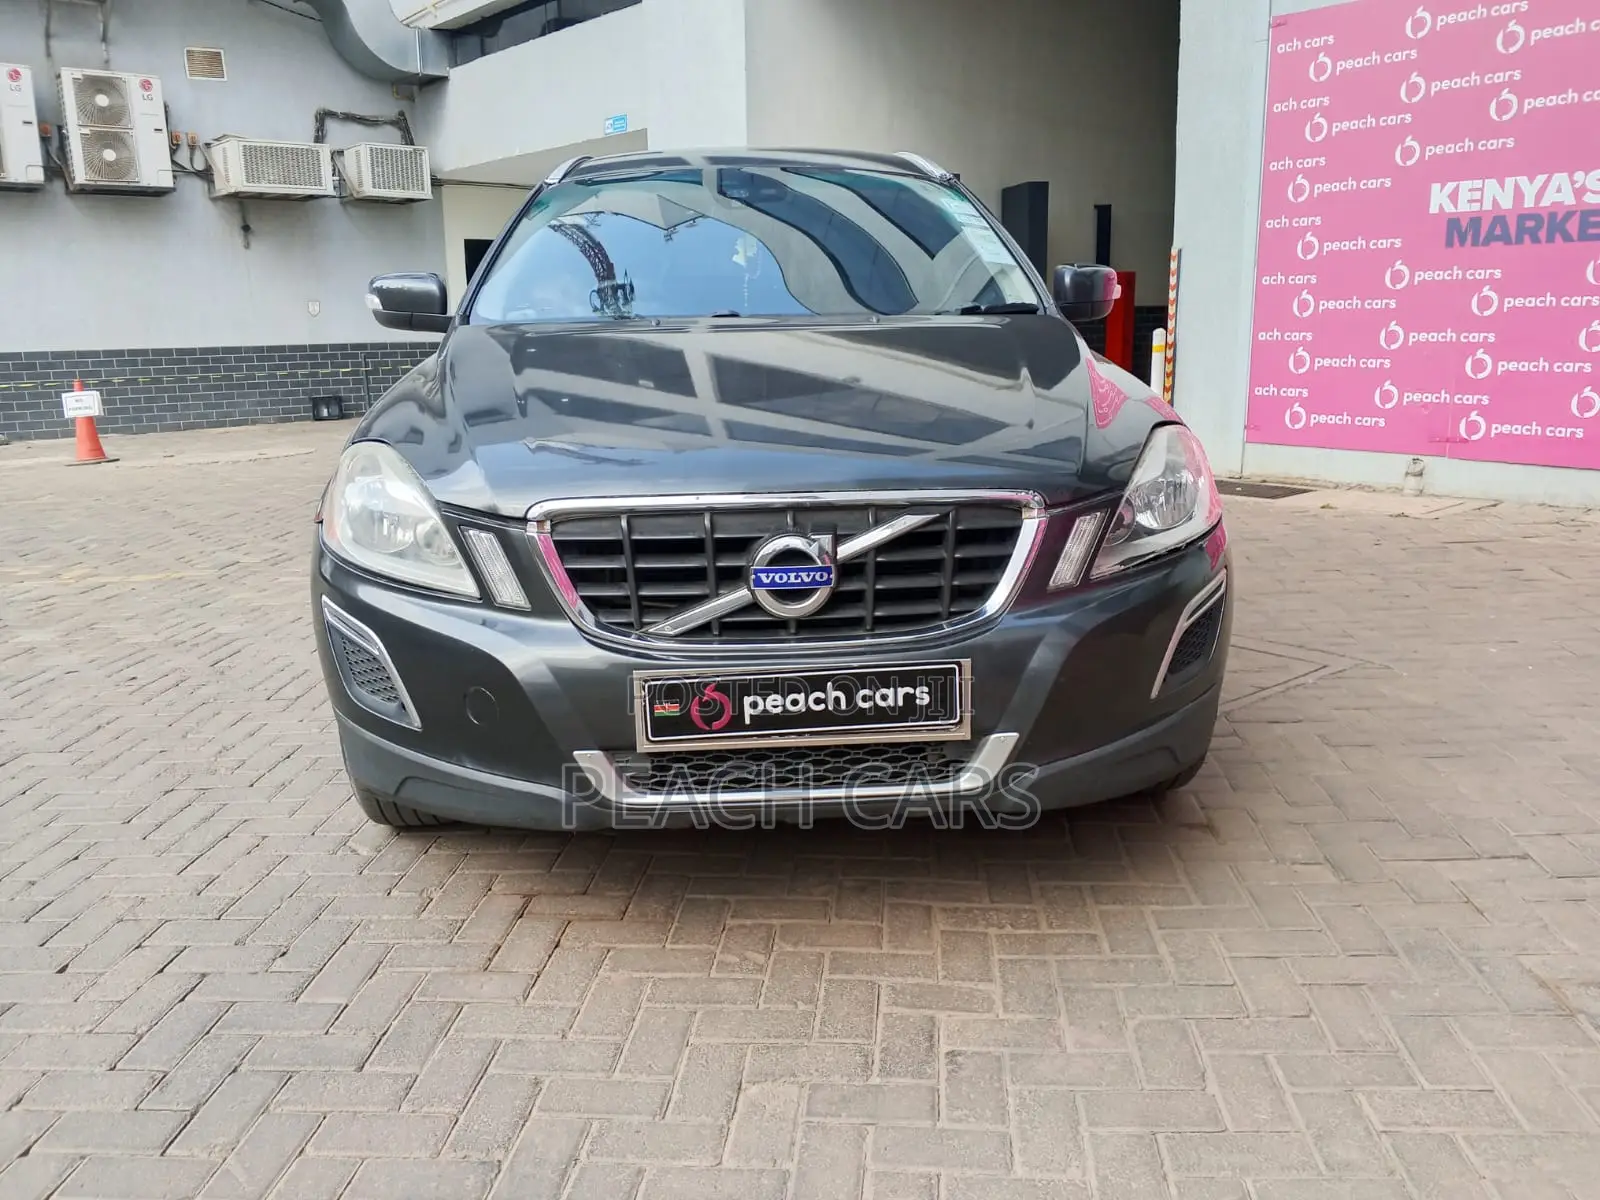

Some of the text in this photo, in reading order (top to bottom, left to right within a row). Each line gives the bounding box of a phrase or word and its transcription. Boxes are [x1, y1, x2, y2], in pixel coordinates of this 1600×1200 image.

[1436, 0, 1529, 31] peach cars
[1530, 17, 1587, 46] peach
[1276, 34, 1335, 54] ach cars
[1335, 49, 1418, 76] peach cars
[1430, 69, 1522, 97] peach cars
[1273, 96, 1330, 113] ach cars
[1522, 88, 1579, 115] peach
[1331, 113, 1412, 137] peach cars
[1425, 137, 1515, 161] peach cars
[1269, 156, 1326, 171] ach cars
[1313, 176, 1392, 198] peach cars
[1428, 168, 1600, 214] KENYA'S
[1265, 214, 1322, 229] ach cars
[1445, 209, 1600, 248] MARKE
[1323, 235, 1402, 256] peach cars
[1261, 271, 1317, 285] ach cars
[1413, 265, 1502, 286] peach cars
[1318, 295, 1397, 314] peach cars
[1503, 291, 1600, 313] peach cars
[1257, 327, 1313, 342] ach cars
[1407, 327, 1496, 347] peach cars
[1313, 353, 1391, 371] peach cars
[1496, 356, 1593, 376] peach cars
[1254, 383, 1309, 398] ach cars
[1402, 388, 1490, 406] peach cars
[1309, 411, 1386, 428] peach cars
[1490, 420, 1585, 439] peach cars
[757, 571, 828, 583] VOLVO
[743, 682, 930, 725] peach cars
